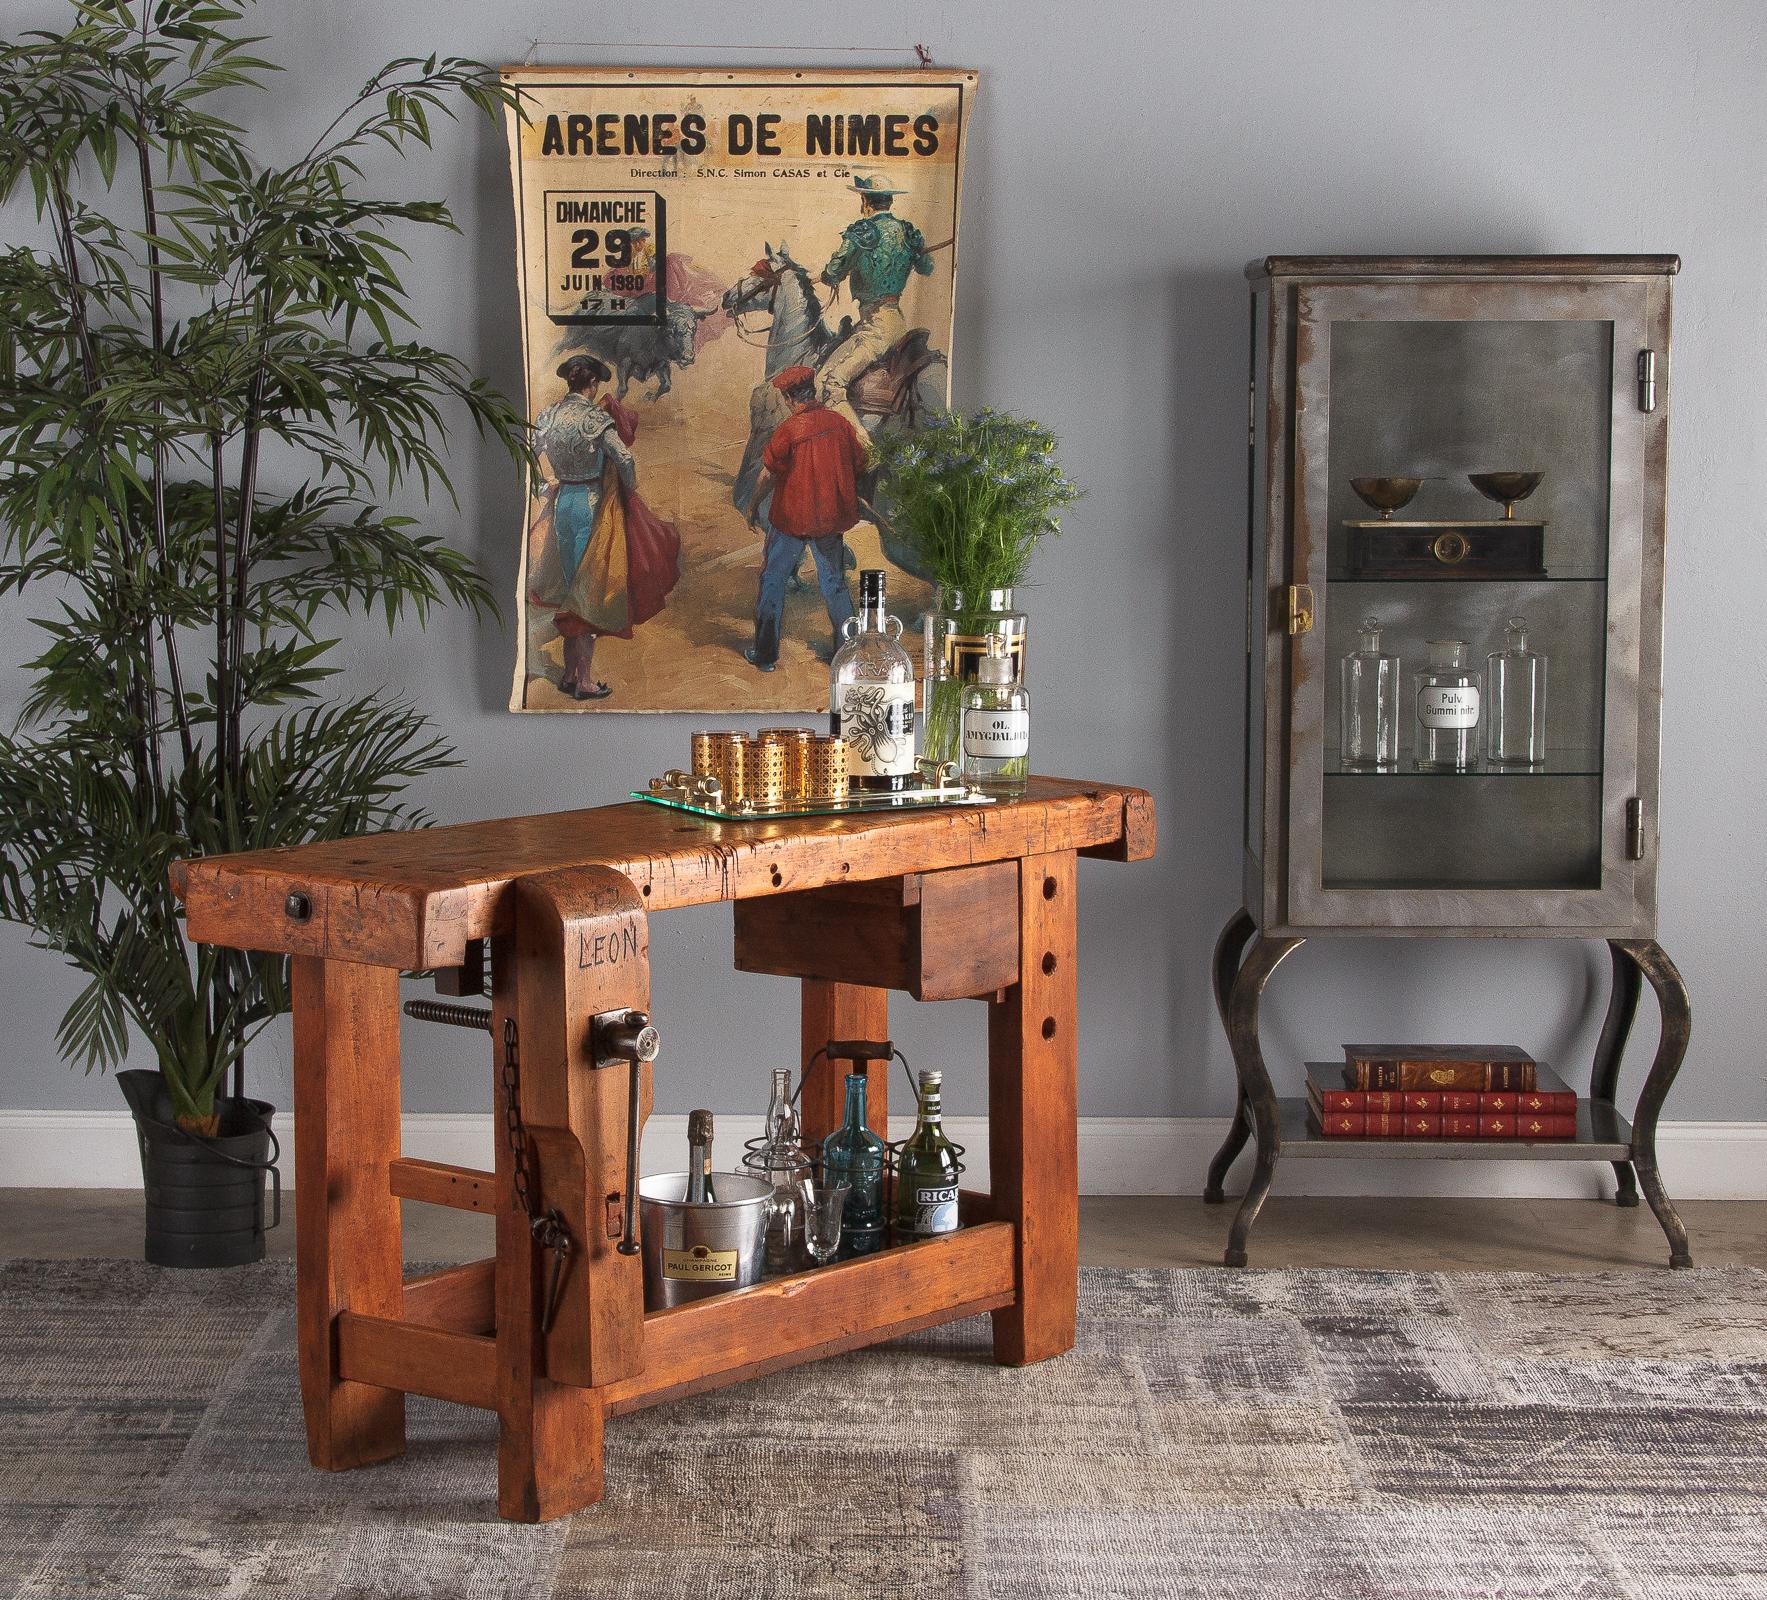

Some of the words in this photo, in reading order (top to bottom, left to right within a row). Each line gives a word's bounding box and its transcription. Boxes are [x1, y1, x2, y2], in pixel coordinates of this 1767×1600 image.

[541, 114, 706, 156] ARENES
[728, 114, 781, 156] DE
[806, 114, 939, 156] NIMES
[630, 168, 678, 178] Direction
[697, 168, 728, 178] S.N.C.
[733, 168, 767, 178] Simon
[772, 168, 811, 178] CASAS
[816, 169, 828, 178] et
[556, 201, 646, 223] DIMANCHE
[571, 229, 632, 269] 29
[560, 274, 602, 291] JUIN
[609, 274, 645, 291] 1980
[610, 299, 626, 310] H
[1426, 704, 1457, 715] Gummi
[992, 720, 1010, 730] OL.
[578, 925, 637, 969] LEON
[667, 1262, 690, 1271] PAUL
[692, 1263, 733, 1272] GERICOT
